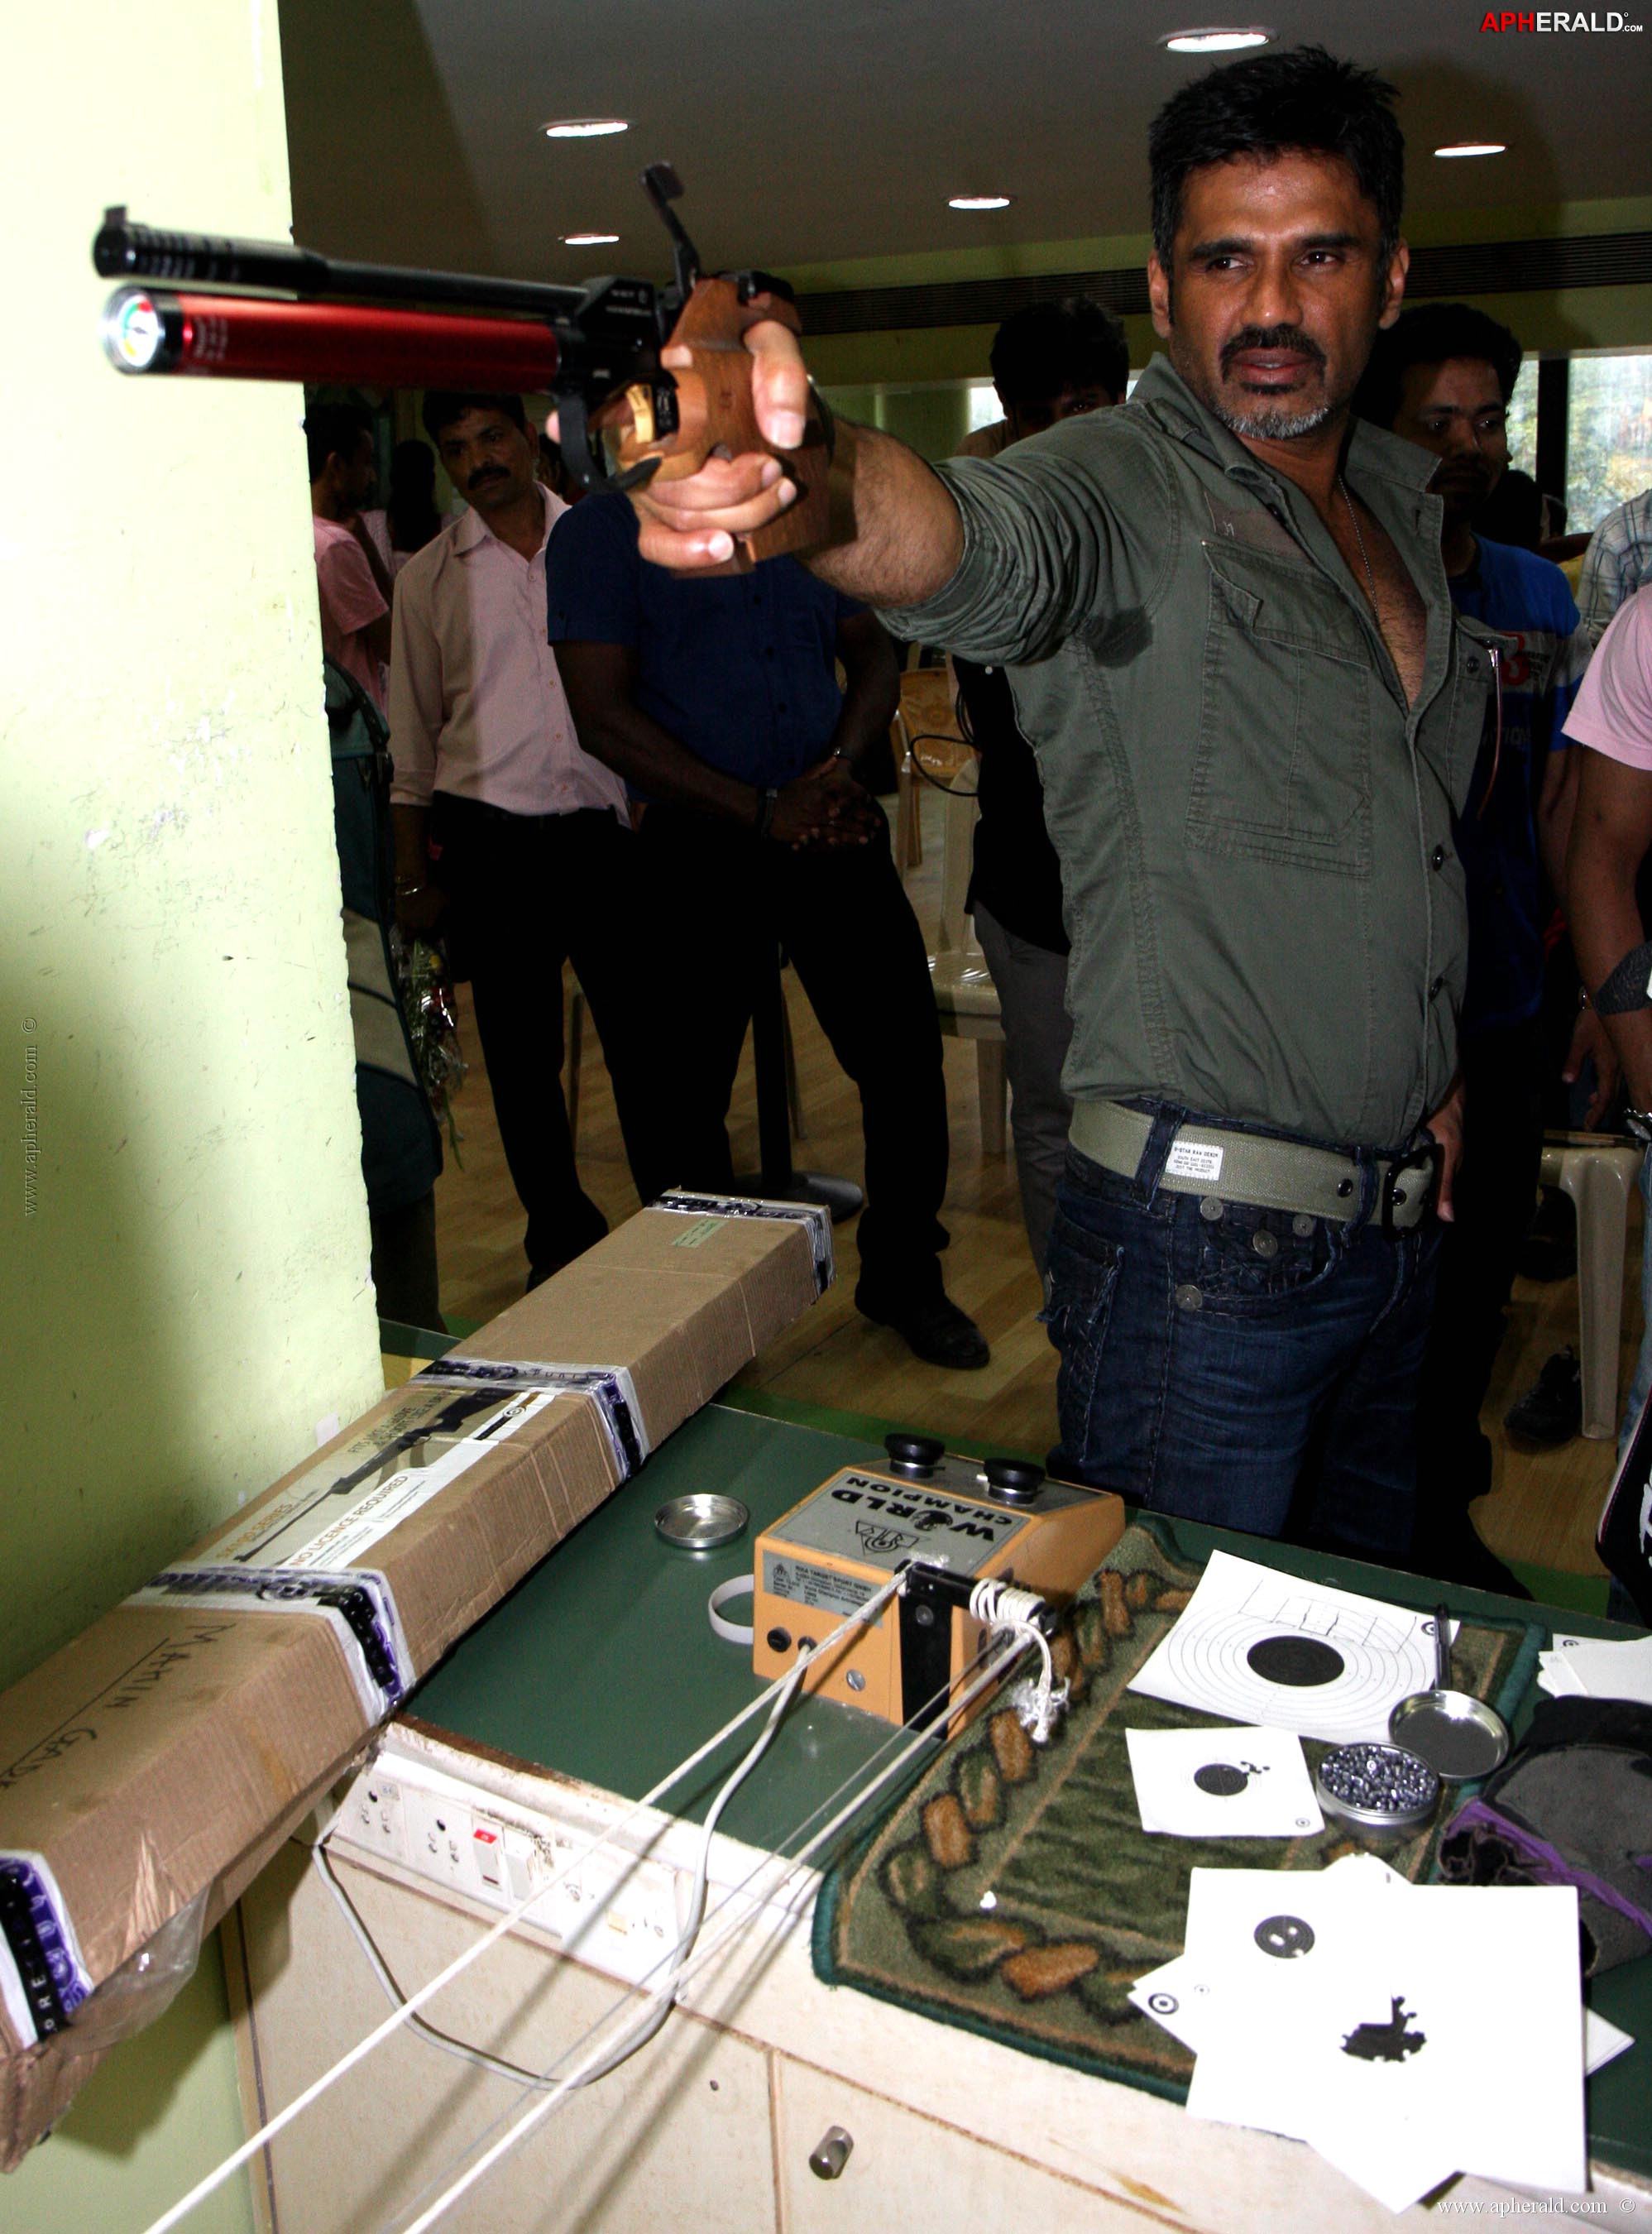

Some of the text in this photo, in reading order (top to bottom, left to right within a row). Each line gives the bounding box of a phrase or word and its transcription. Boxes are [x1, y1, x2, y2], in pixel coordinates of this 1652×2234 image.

[309, 1516, 359, 1552] LICENCE
[352, 1475, 409, 1518] REQUIRED
[831, 1489, 994, 1541] WORLD
[846, 1477, 1013, 1525] CHAMPION
